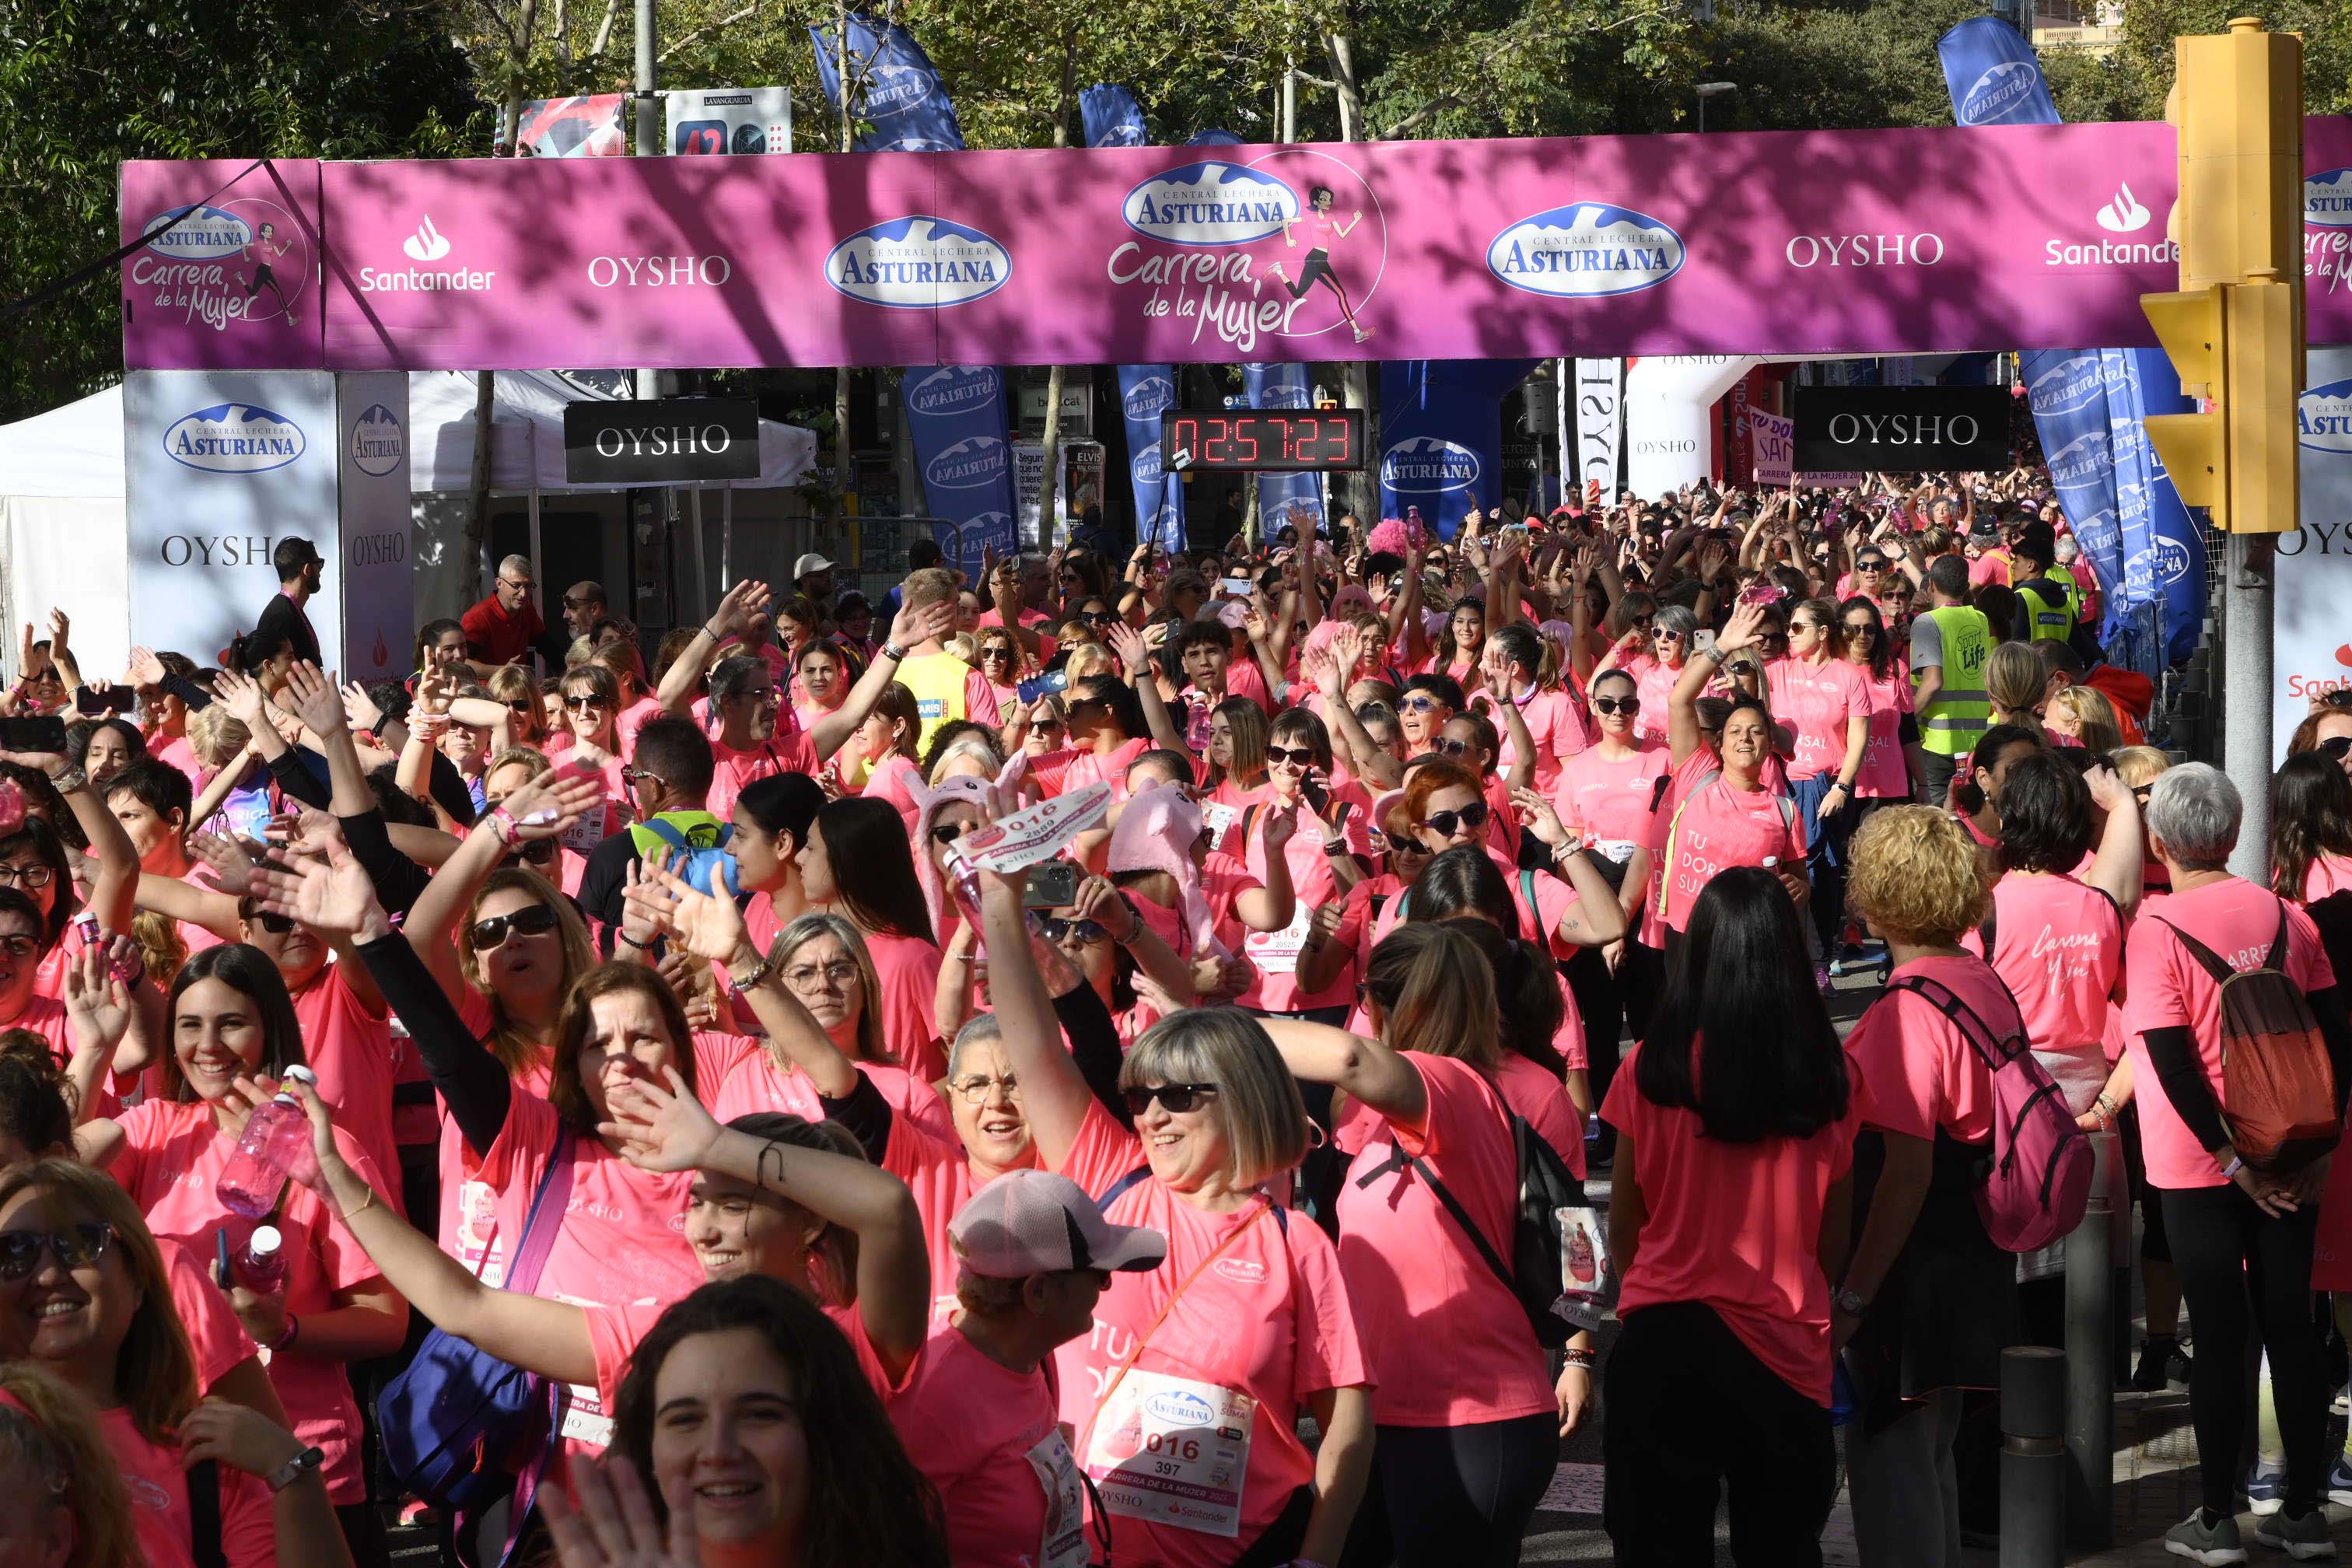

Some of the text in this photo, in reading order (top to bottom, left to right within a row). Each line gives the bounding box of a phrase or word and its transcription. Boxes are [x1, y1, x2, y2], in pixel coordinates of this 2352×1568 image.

[1163, 189, 1279, 200] CENTRAL LECHERA
[1136, 192, 1285, 225] ASTURIANA
[867, 246, 991, 257] CENTRAL LECHERA
[1532, 233, 1663, 246] CENTRAL LECHERA
[1786, 233, 1944, 268] OYSHO
[2046, 237, 2182, 266] Santande
[840, 250, 996, 285] ASTURIANA
[1107, 241, 1252, 285] Carrera
[1504, 238, 1671, 275] ASTURIANA
[132, 256, 223, 285] Carrera
[360, 266, 495, 292] Santander
[587, 255, 730, 288] OYSHO
[2318, 254, 2332, 276] la
[2328, 254, 2352, 296] M
[155, 283, 258, 331] de la Mujer
[1143, 278, 1307, 352] de la Mujer
[1751, 412, 1769, 428] TU
[1829, 413, 1979, 446] OYSHO
[174, 429, 296, 456] ASTURIANA
[355, 431, 401, 459] ASTURIANA
[596, 424, 730, 457] OYSHO
[1175, 419, 1348, 461] 02:57:23
[1636, 439, 1696, 455] OYSHO
[1077, 452, 1101, 462] ELVIS
[1020, 466, 1032, 474] que
[1020, 475, 1045, 484] quiere
[1384, 459, 1472, 481] ASTURIANA
[1757, 468, 1790, 479] CARRERA
[1020, 495, 1034, 505] este
[161, 535, 304, 566] OYSH
[353, 531, 404, 566] OYSHO
[1957, 630, 1983, 652] Sport
[1962, 645, 1985, 670] Life
[1795, 733, 1828, 750] RSAL
[1867, 736, 1889, 747] SAL
[1794, 751, 1813, 764] MA
[227, 809, 268, 821] URICH
[1009, 803, 1057, 831] 016
[1024, 819, 1055, 838] 2889
[1686, 830, 1708, 849] TU
[989, 842, 1028, 857] CARRERA
[1029, 837, 1041, 846] DE
[1044, 831, 1055, 842] LA
[1564, 1304, 1598, 1322] OYSHO
[1090, 1318, 1133, 1360] TU
[586, 1404, 601, 1412] DE
[1150, 1398, 1209, 1422] ASTURIANA
[1220, 1409, 1245, 1419] SUMA
[1146, 1432, 1199, 1461] 016
[1154, 1461, 1181, 1476] 397
[1103, 1472, 1146, 1487] CARRERA
[1149, 1479, 1159, 1489] DE
[1162, 1482, 1174, 1492] LA
[1175, 1486, 1207, 1497] MUJER
[1097, 1489, 1143, 1508] OYSHO
[1181, 1506, 1228, 1524] Santander
